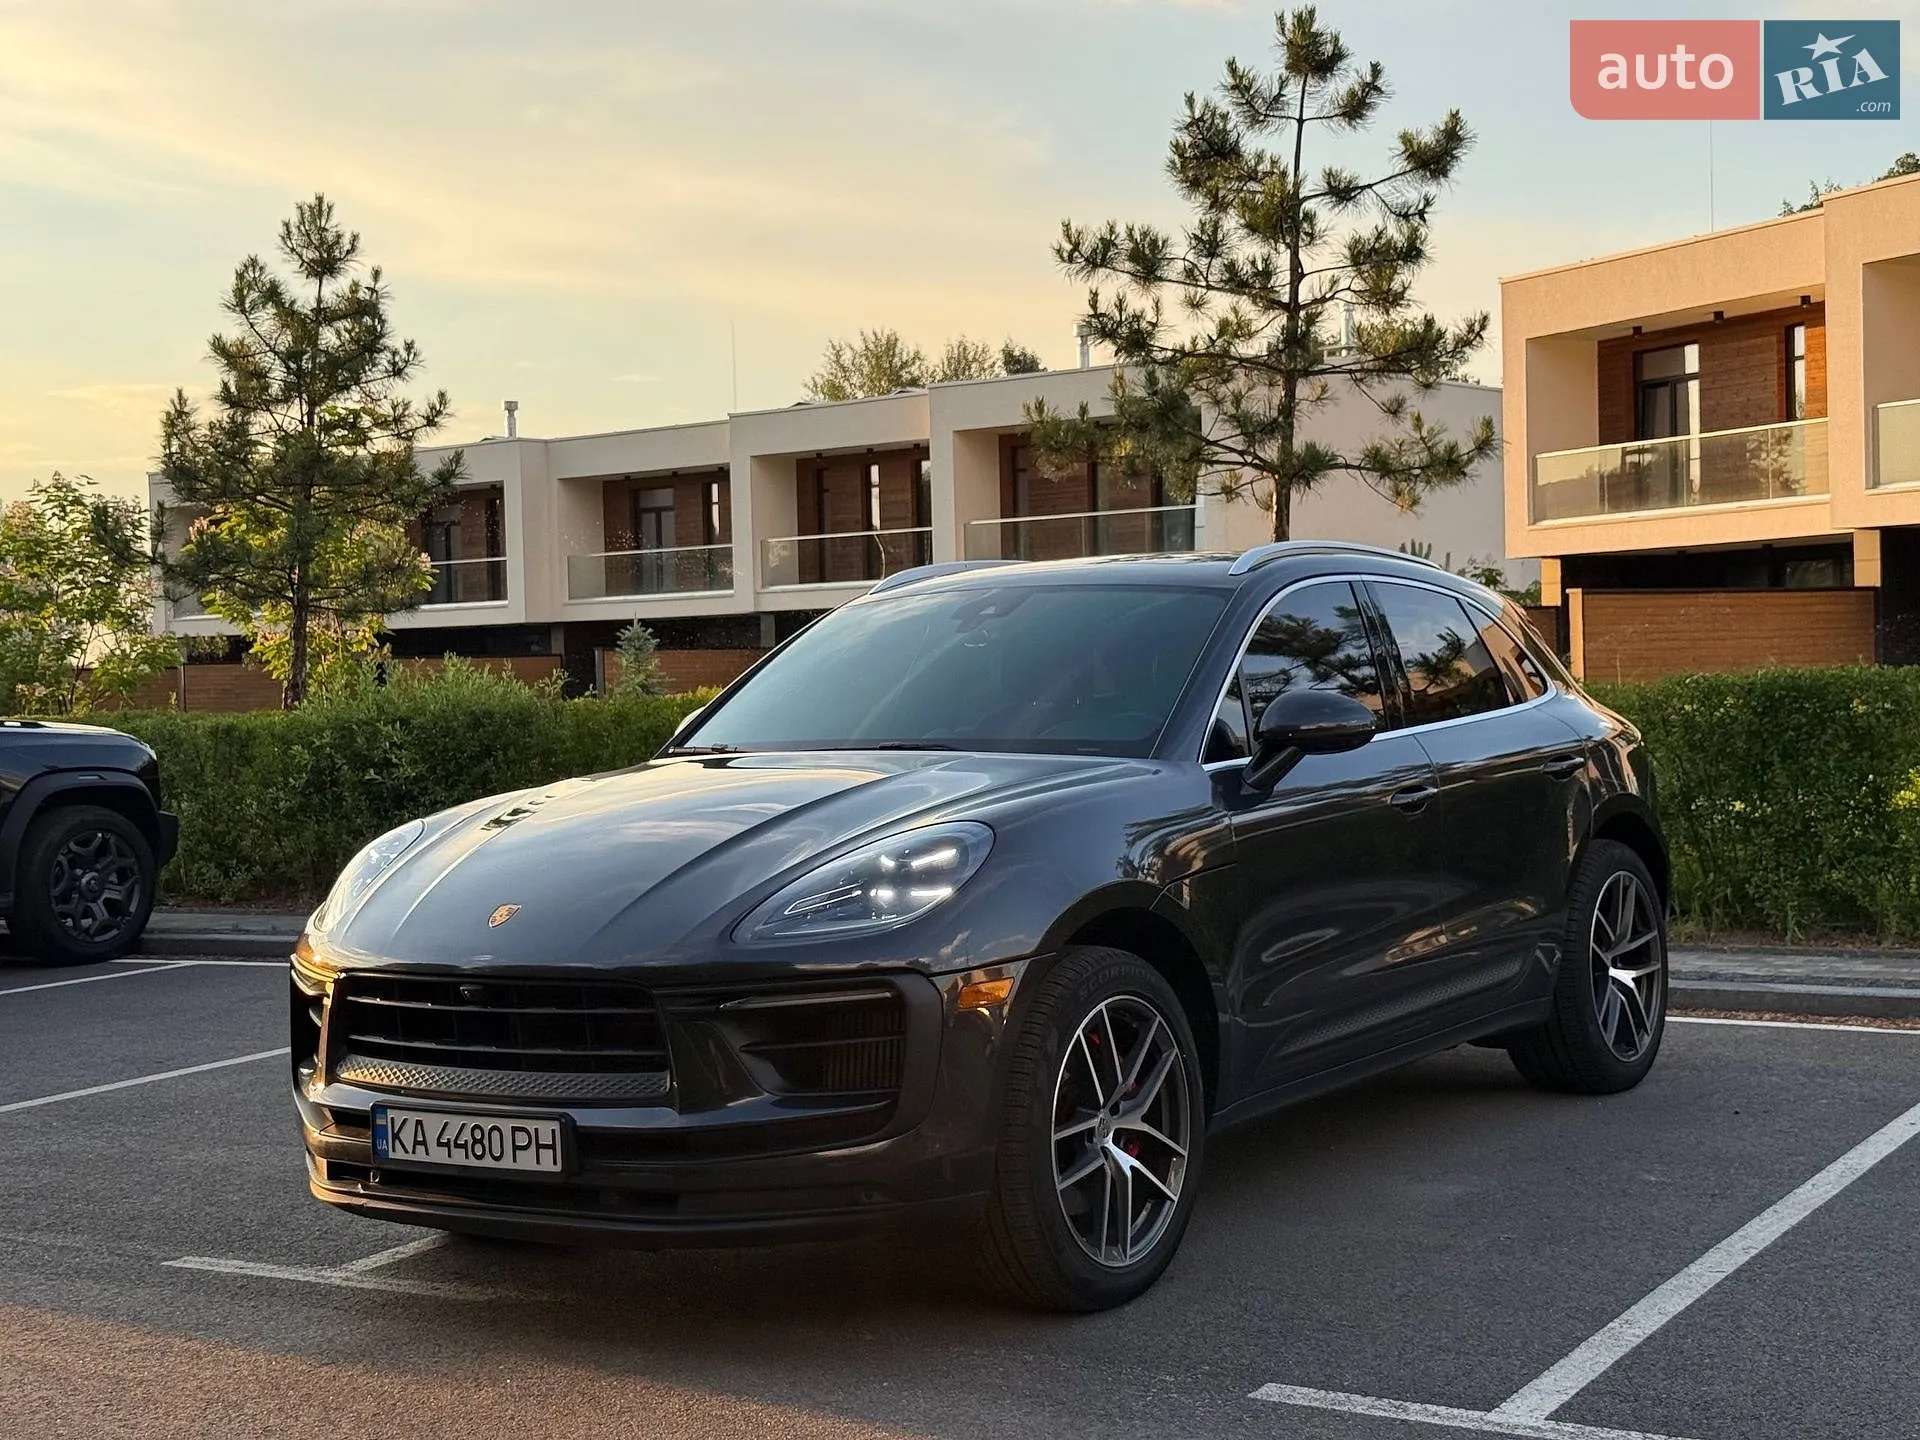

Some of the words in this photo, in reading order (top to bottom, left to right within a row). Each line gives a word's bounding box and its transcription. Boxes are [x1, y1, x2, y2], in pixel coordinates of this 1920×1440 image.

[376, 1140, 388, 1151] UA
[389, 1115, 430, 1156] KA
[436, 1120, 504, 1162] 4480
[511, 1125, 558, 1166] PH
